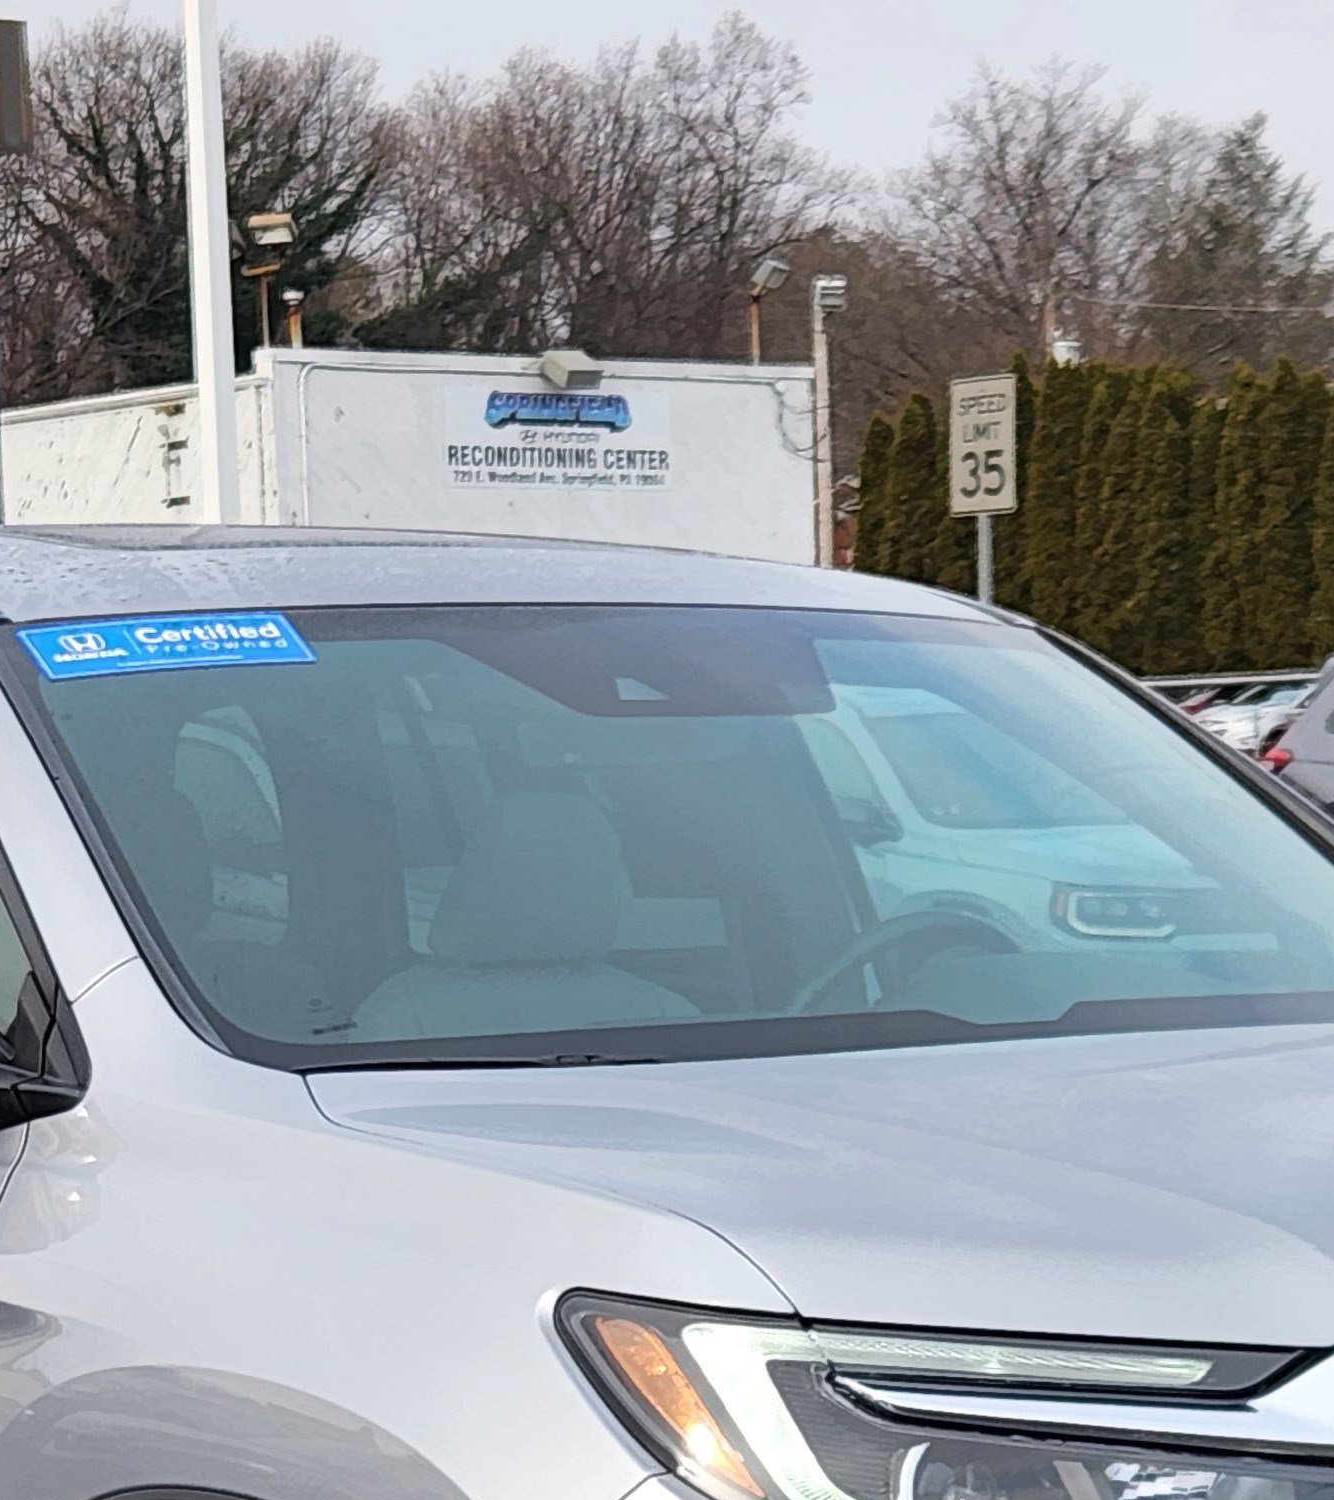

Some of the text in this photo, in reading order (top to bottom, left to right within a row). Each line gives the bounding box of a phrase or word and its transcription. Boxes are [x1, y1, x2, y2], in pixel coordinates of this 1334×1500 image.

[958, 393, 1006, 417] SPEED
[961, 420, 1002, 444] LIMIT
[447, 445, 670, 470] RECONDITIONING CENTER
[959, 449, 1006, 498] 35
[134, 621, 282, 644] Certified
[52, 648, 130, 663] HONDA
